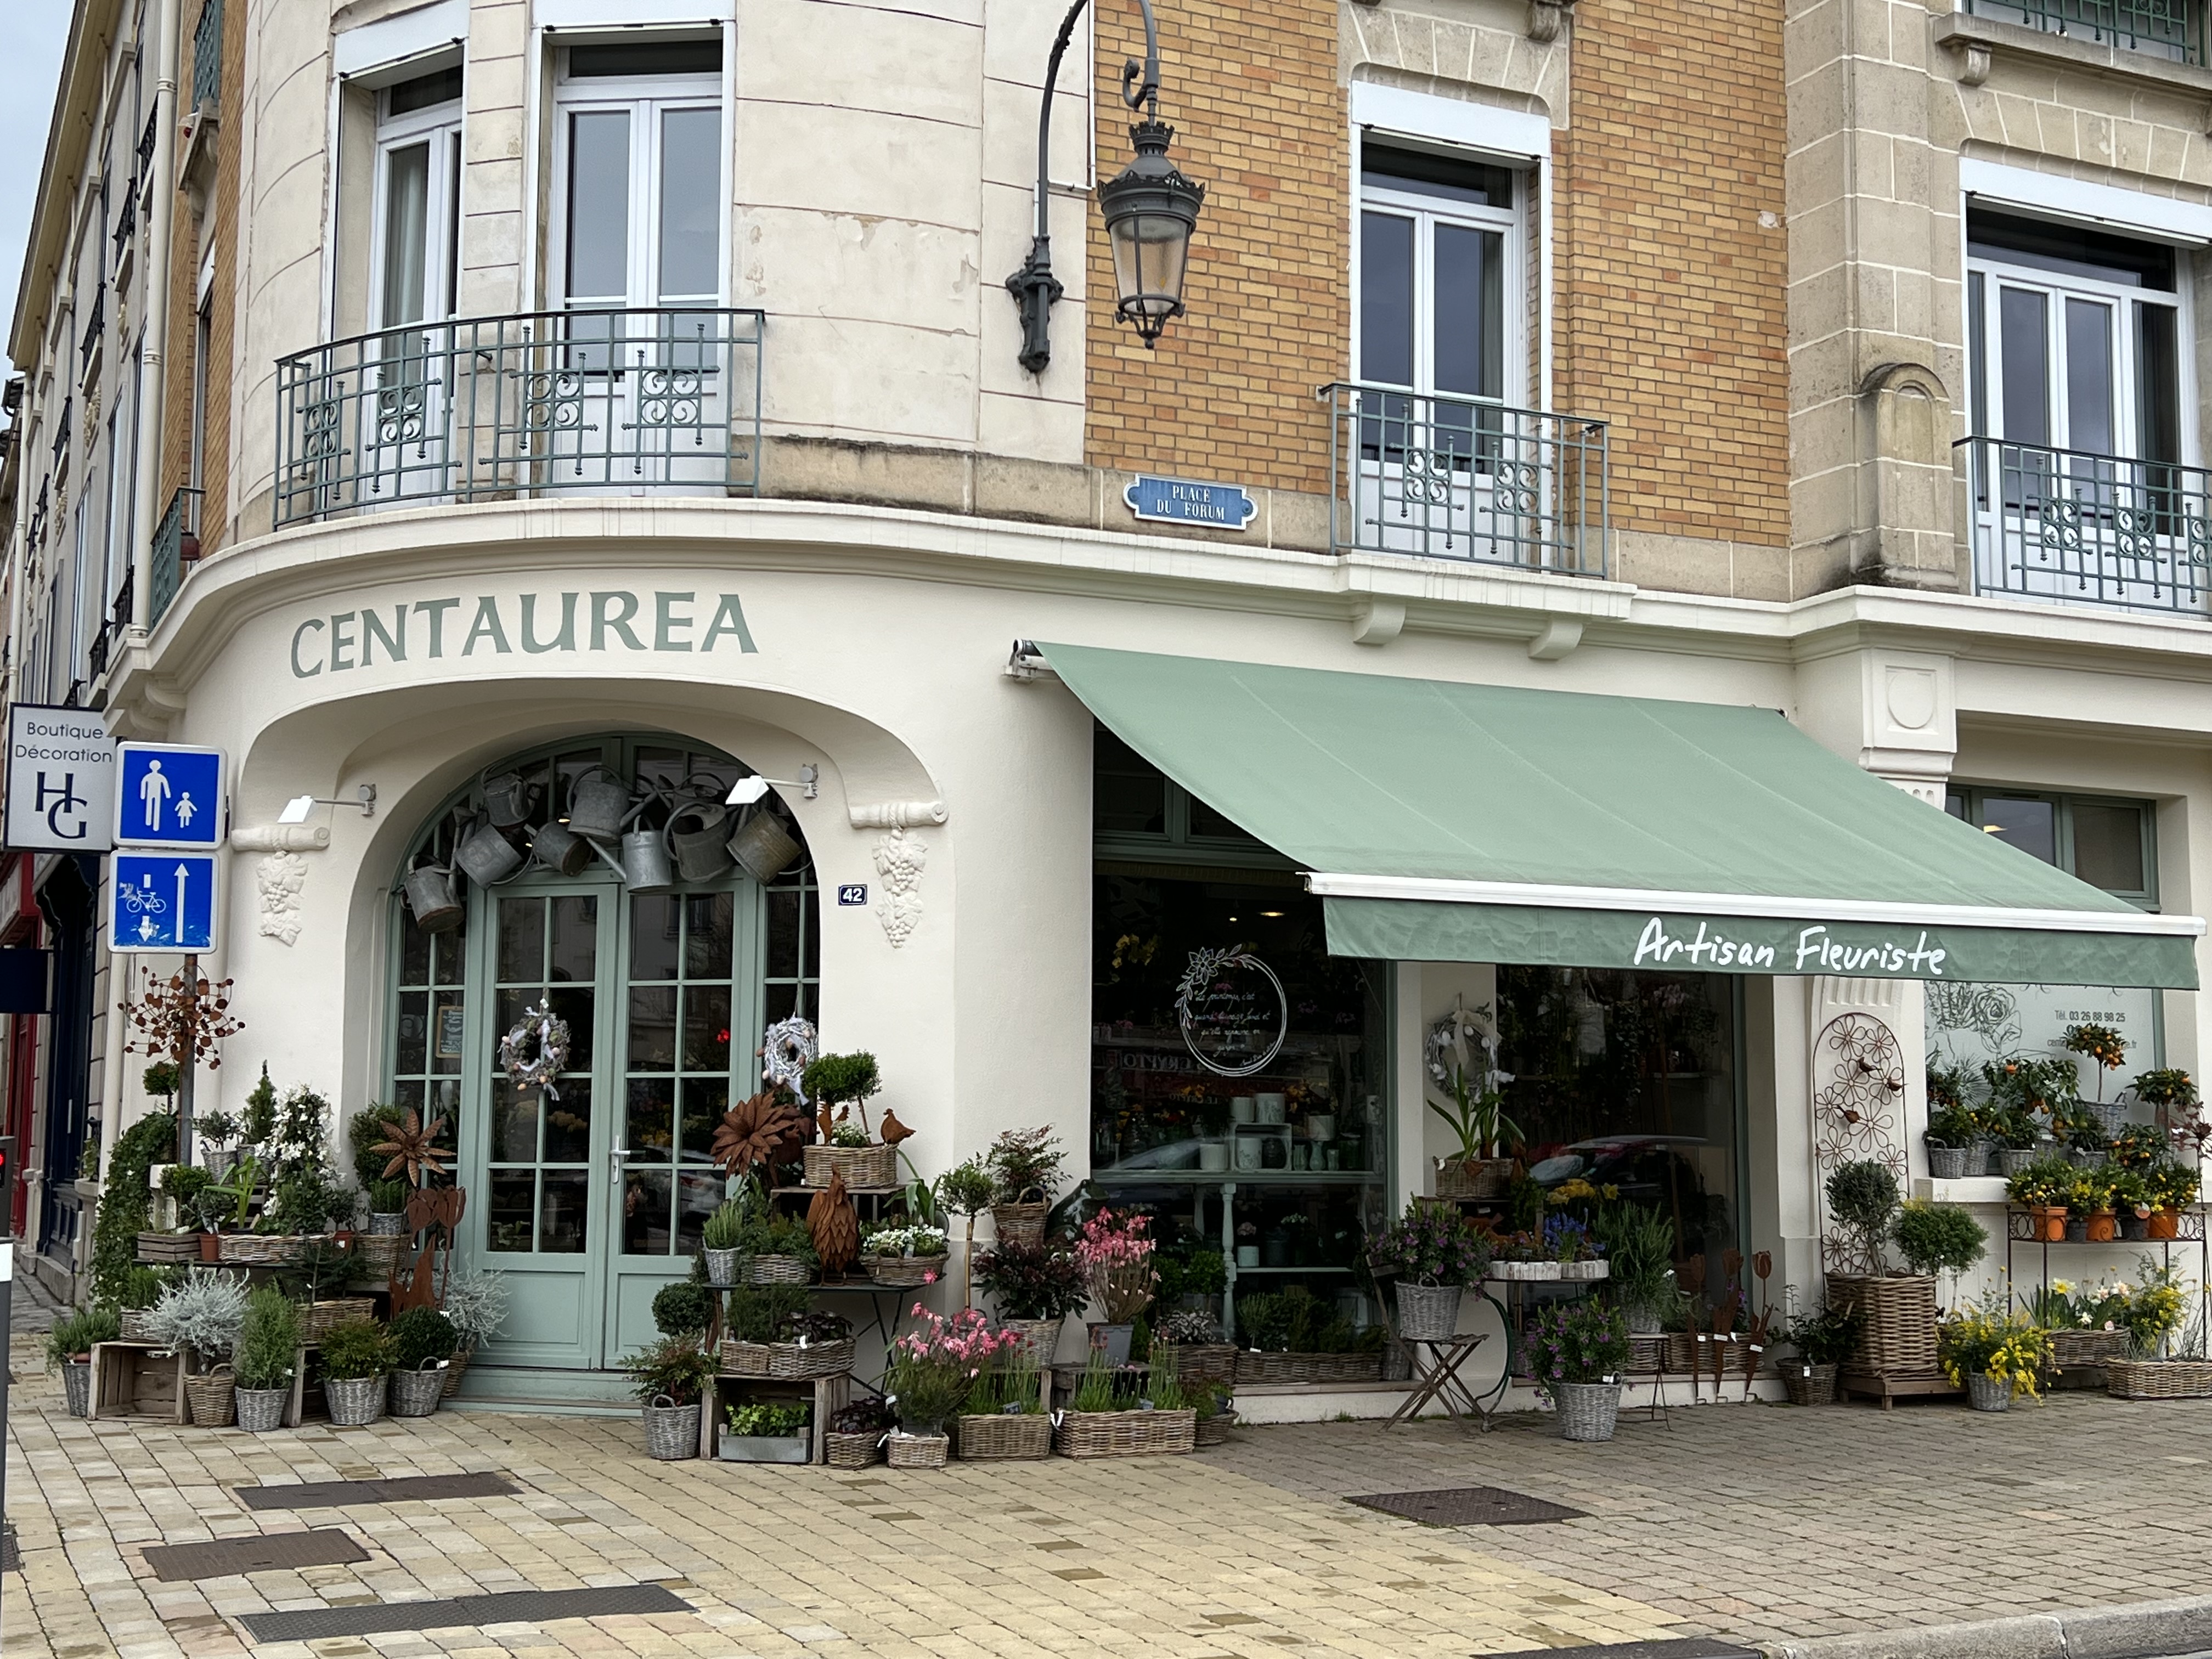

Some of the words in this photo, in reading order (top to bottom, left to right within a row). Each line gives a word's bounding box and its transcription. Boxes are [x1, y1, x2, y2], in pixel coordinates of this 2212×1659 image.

[1172, 485, 1211, 503] PLACE
[1156, 499, 1172, 514] DU
[1184, 502, 1225, 521] FORUM
[291, 590, 759, 679] CENTAUREA
[26, 721, 104, 741] Boutique
[15, 744, 112, 763] Décoration
[842, 888, 863, 902] 42
[1633, 917, 1775, 968] Artisan
[1795, 925, 1946, 975] Fleuriste
[2069, 1011, 2079, 1020] 03
[2081, 1011, 2091, 1021] 26
[2092, 1012, 2102, 1022] 88
[2115, 1013, 2126, 1023] 25
